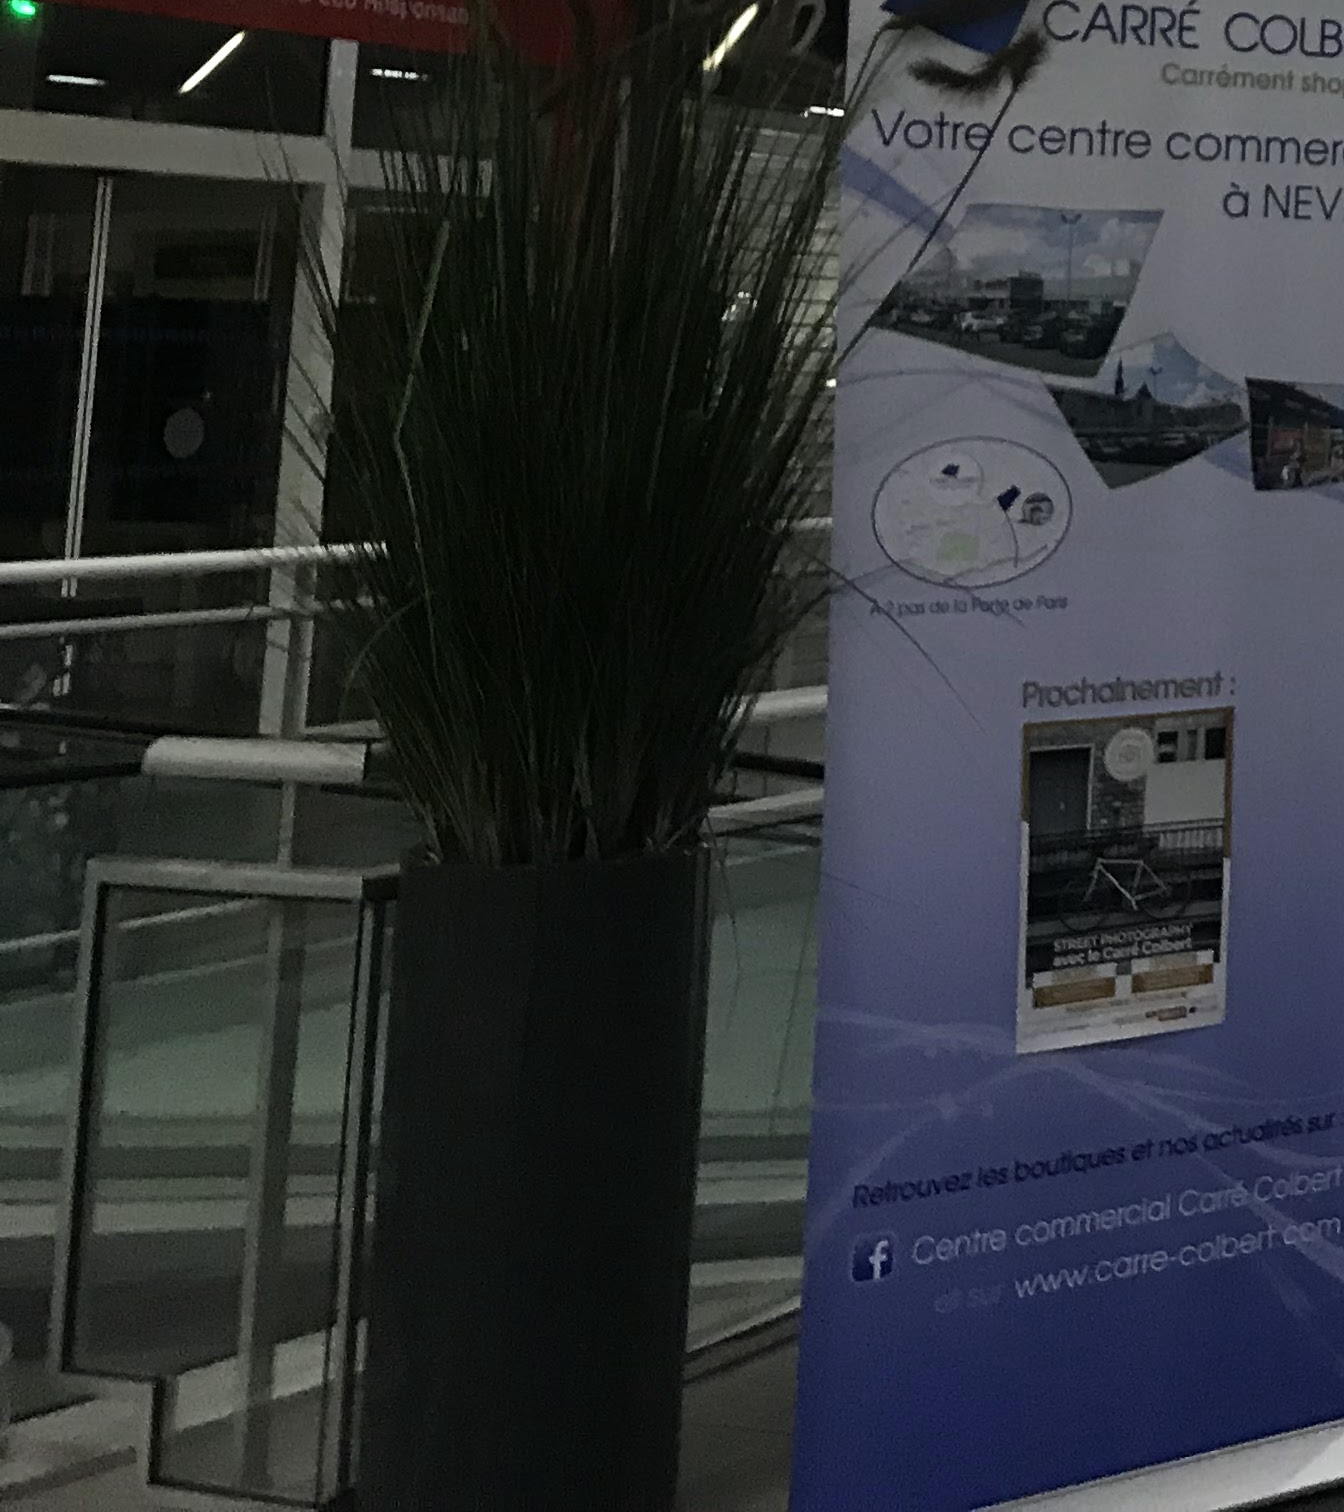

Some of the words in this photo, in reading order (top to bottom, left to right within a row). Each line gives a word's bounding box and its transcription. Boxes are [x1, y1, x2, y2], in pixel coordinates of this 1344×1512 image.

[1042, 0, 1201, 50] CARRÉ
[1160, 62, 1295, 93] Carrément
[870, 110, 993, 153] Votre
[1007, 119, 1152, 159] centre
[1223, 184, 1250, 219] à
[1021, 669, 1223, 708] Prochainement
[851, 1170, 970, 1210] Retrouvez
[975, 1164, 1009, 1189] les
[1013, 1145, 1126, 1182] boutiques
[1131, 1137, 1156, 1163] et
[1159, 1134, 1198, 1158] nos
[1201, 1115, 1304, 1153] actualités
[1306, 1110, 1336, 1133] sur
[911, 1225, 1008, 1267] Centre
[1014, 1193, 1171, 1248] commercial
[1177, 1180, 1249, 1219] Carré
[1253, 1164, 1344, 1202] Colbert
[1014, 1213, 1342, 1300] www.carre-colbert.com
